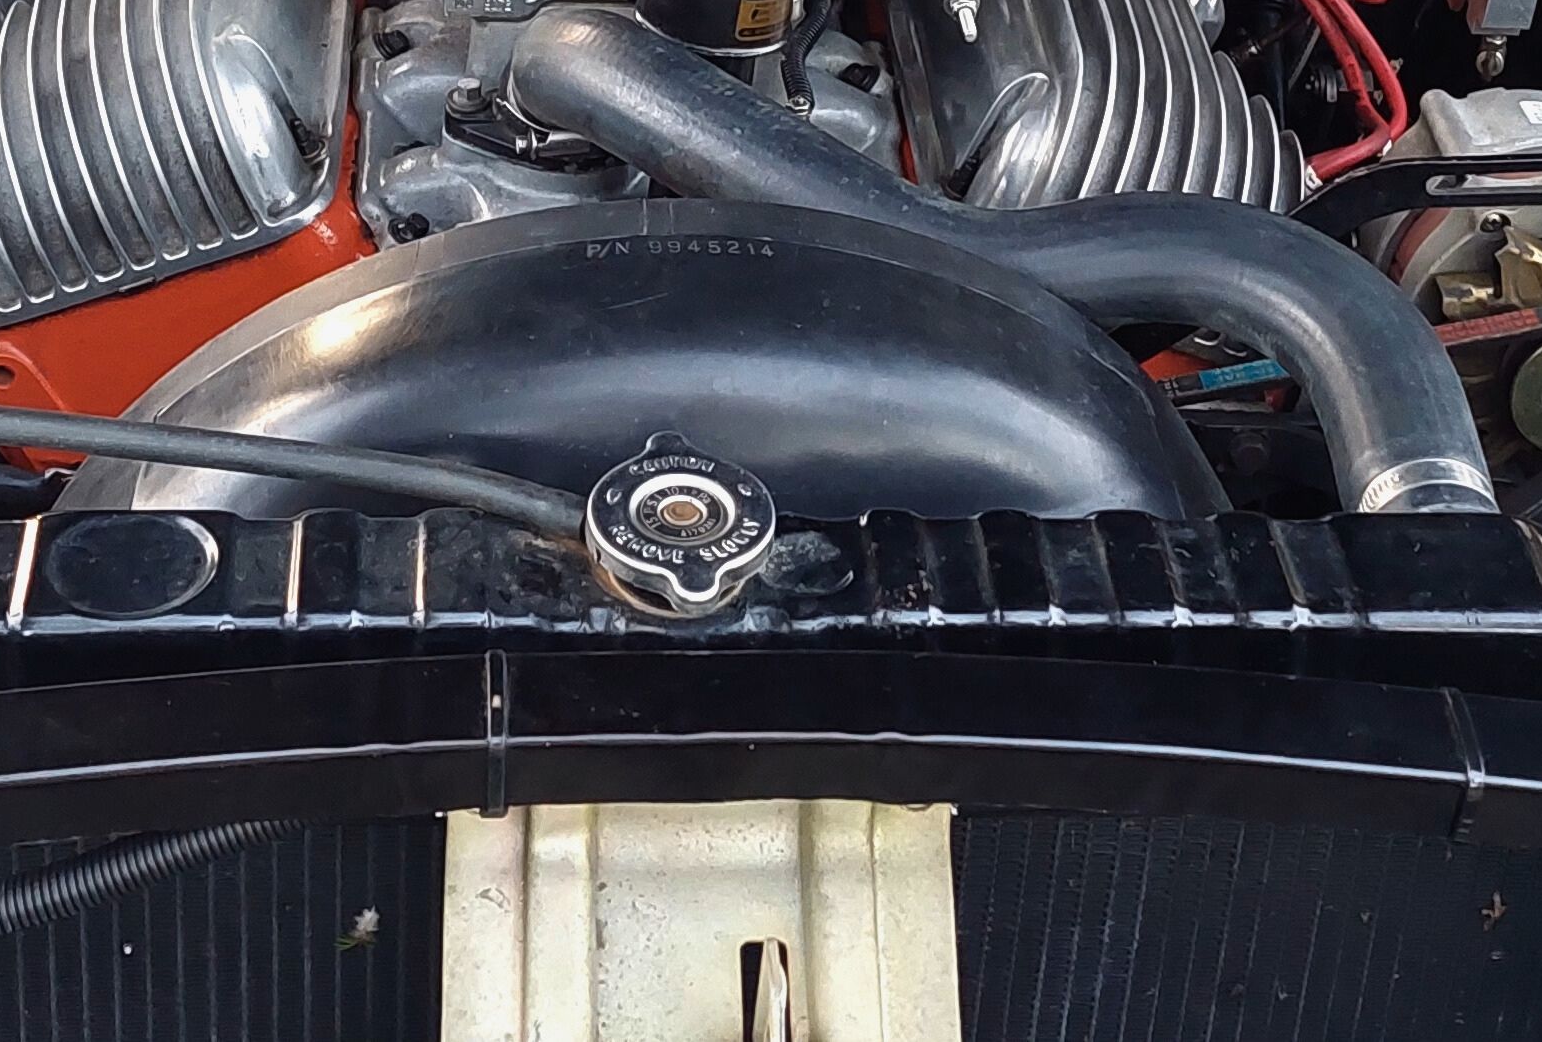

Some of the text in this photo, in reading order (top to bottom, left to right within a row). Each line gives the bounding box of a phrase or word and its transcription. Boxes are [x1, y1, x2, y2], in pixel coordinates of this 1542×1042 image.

[586, 240, 775, 258] P/N 9945214
[609, 524, 685, 564] REMOVE
